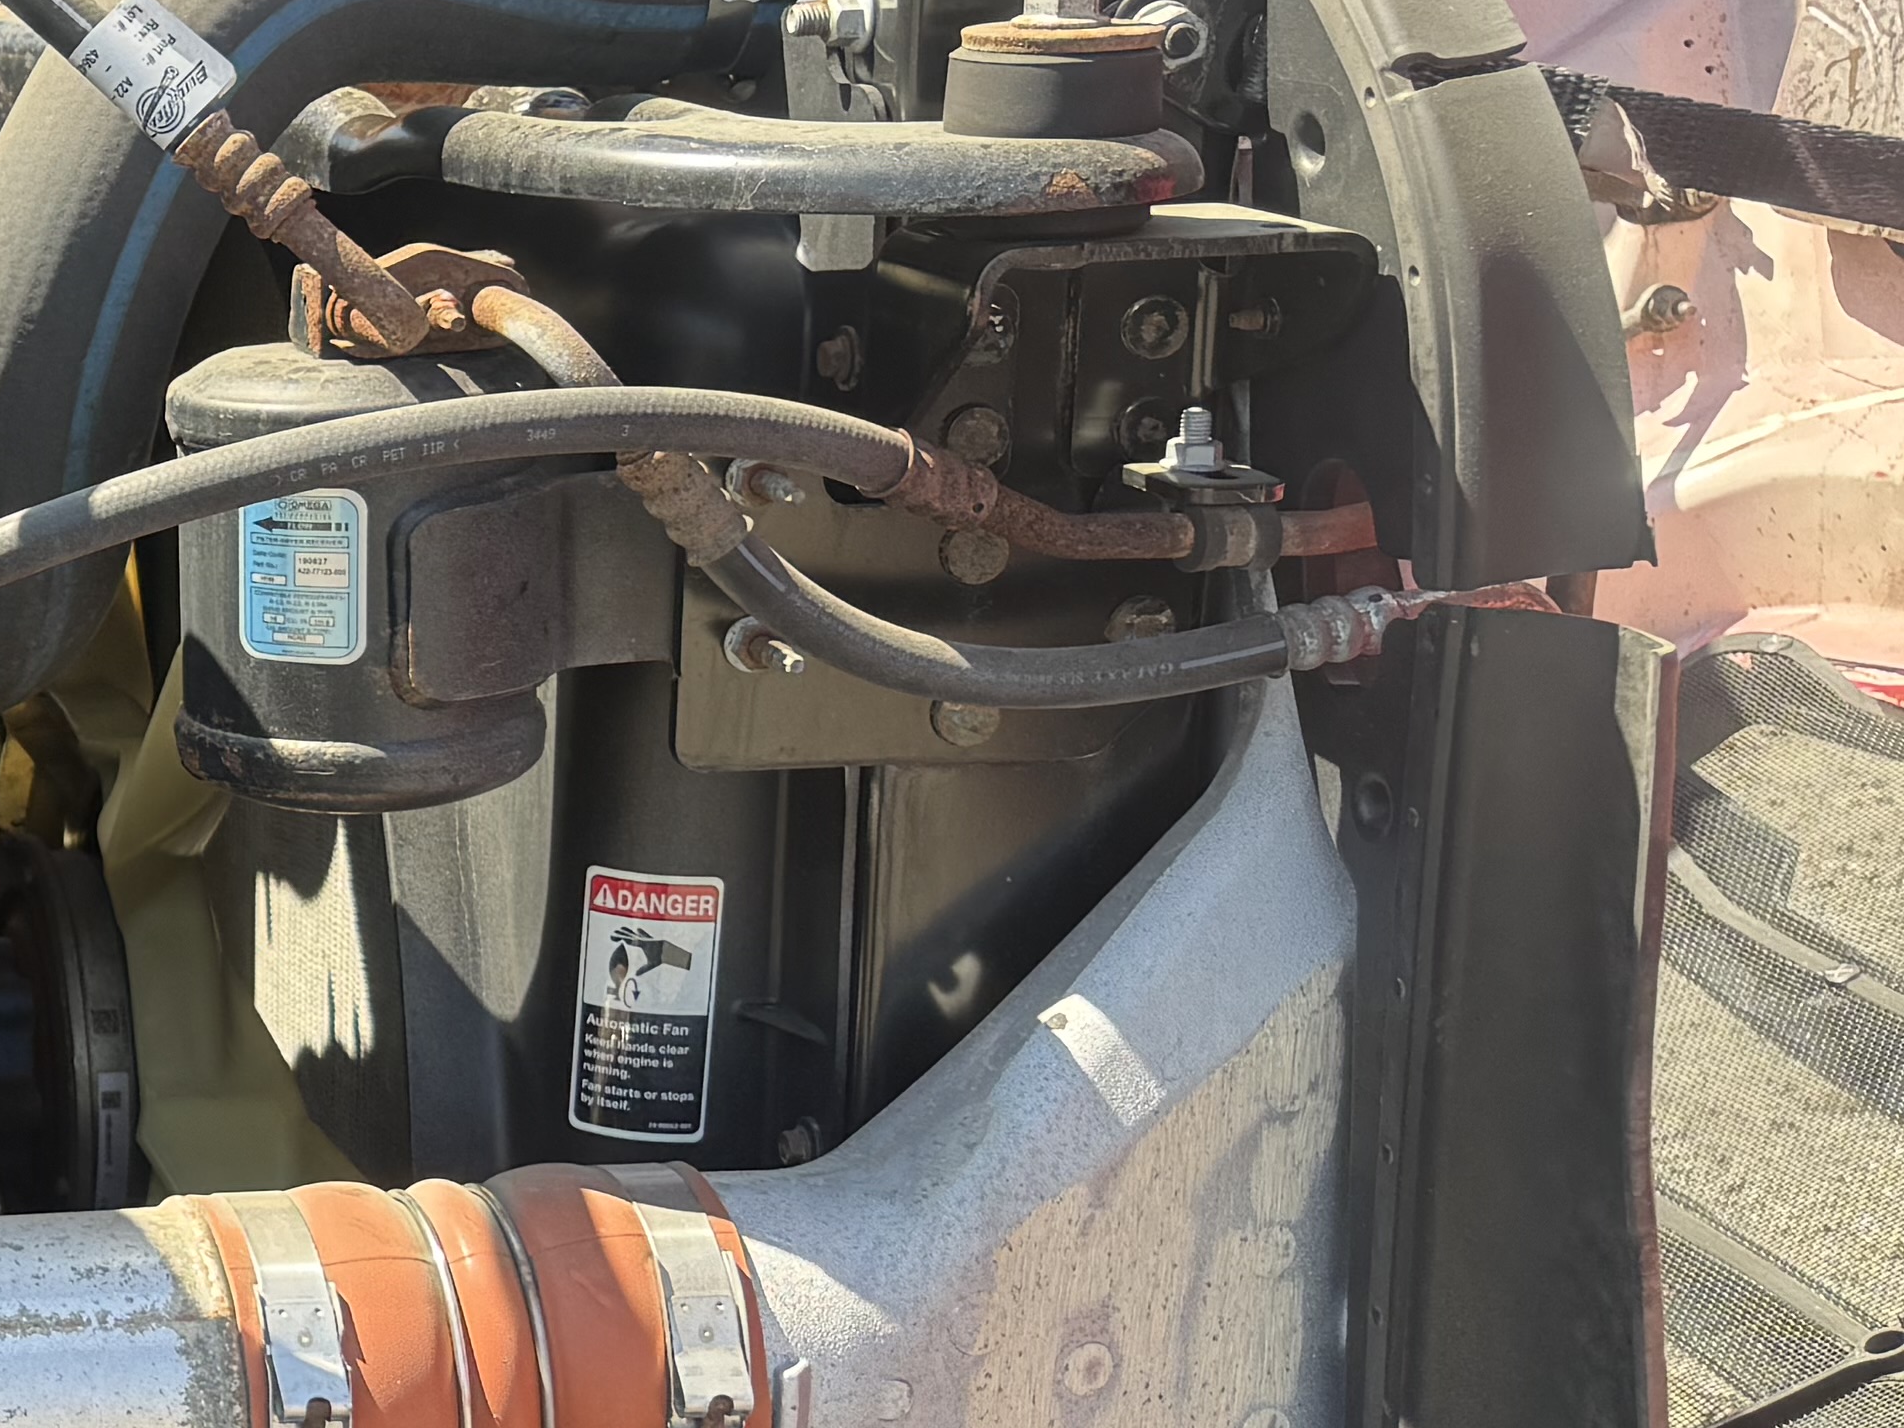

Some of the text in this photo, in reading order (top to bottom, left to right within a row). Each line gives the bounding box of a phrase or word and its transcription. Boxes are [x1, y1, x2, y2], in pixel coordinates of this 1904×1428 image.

[152, 33, 177, 56] Part
[527, 428, 556, 442] 3449
[289, 468, 307, 483] CR
[351, 455, 368, 469] CR
[382, 447, 406, 462] PET
[422, 441, 444, 456] IIR
[617, 889, 715, 916] DANGER
[586, 1013, 689, 1036] Automatic Fan
[585, 1033, 690, 1055] Keep hands clear
[584, 1048, 674, 1068] when engine is
[583, 1062, 631, 1080] running.
[580, 1092, 631, 1112] by itself.
[581, 1079, 695, 1103] Fan starts or stops
